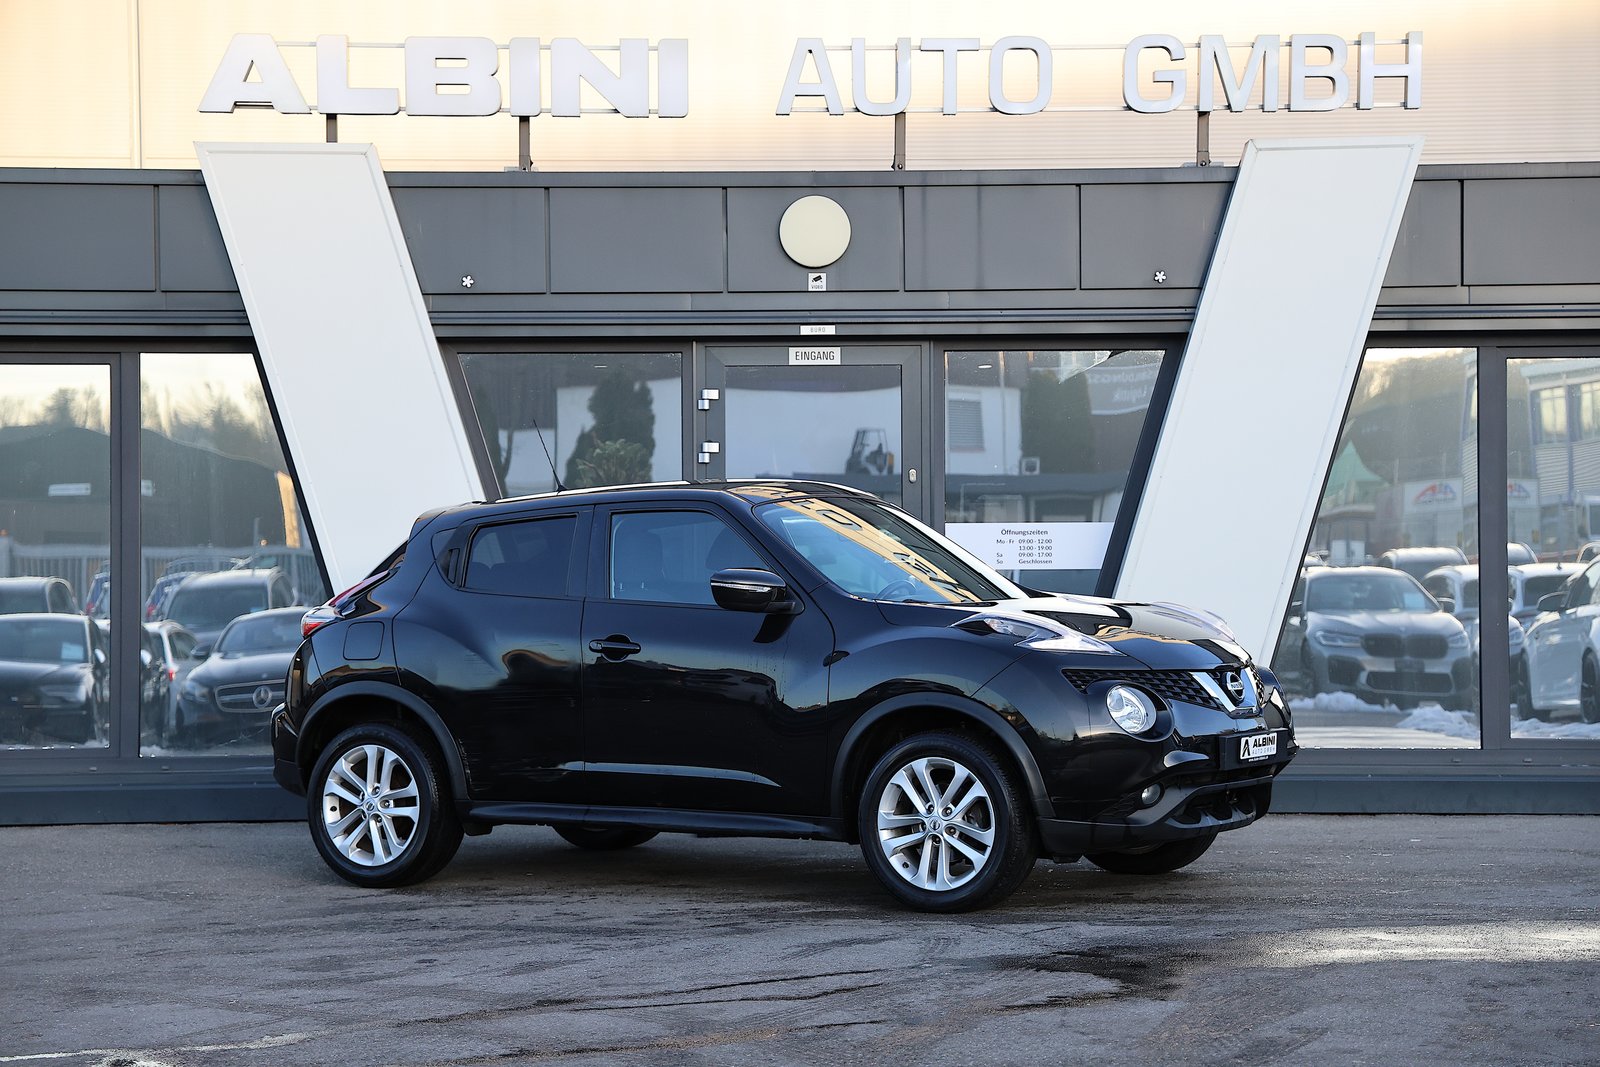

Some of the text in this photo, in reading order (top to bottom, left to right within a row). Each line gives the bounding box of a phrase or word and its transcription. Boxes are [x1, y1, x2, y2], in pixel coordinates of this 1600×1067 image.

[198, 31, 1423, 118] ALBINI AUTO GMBH
[795, 350, 835, 361] EINGANG
[1253, 736, 1275, 748] ALBINI
